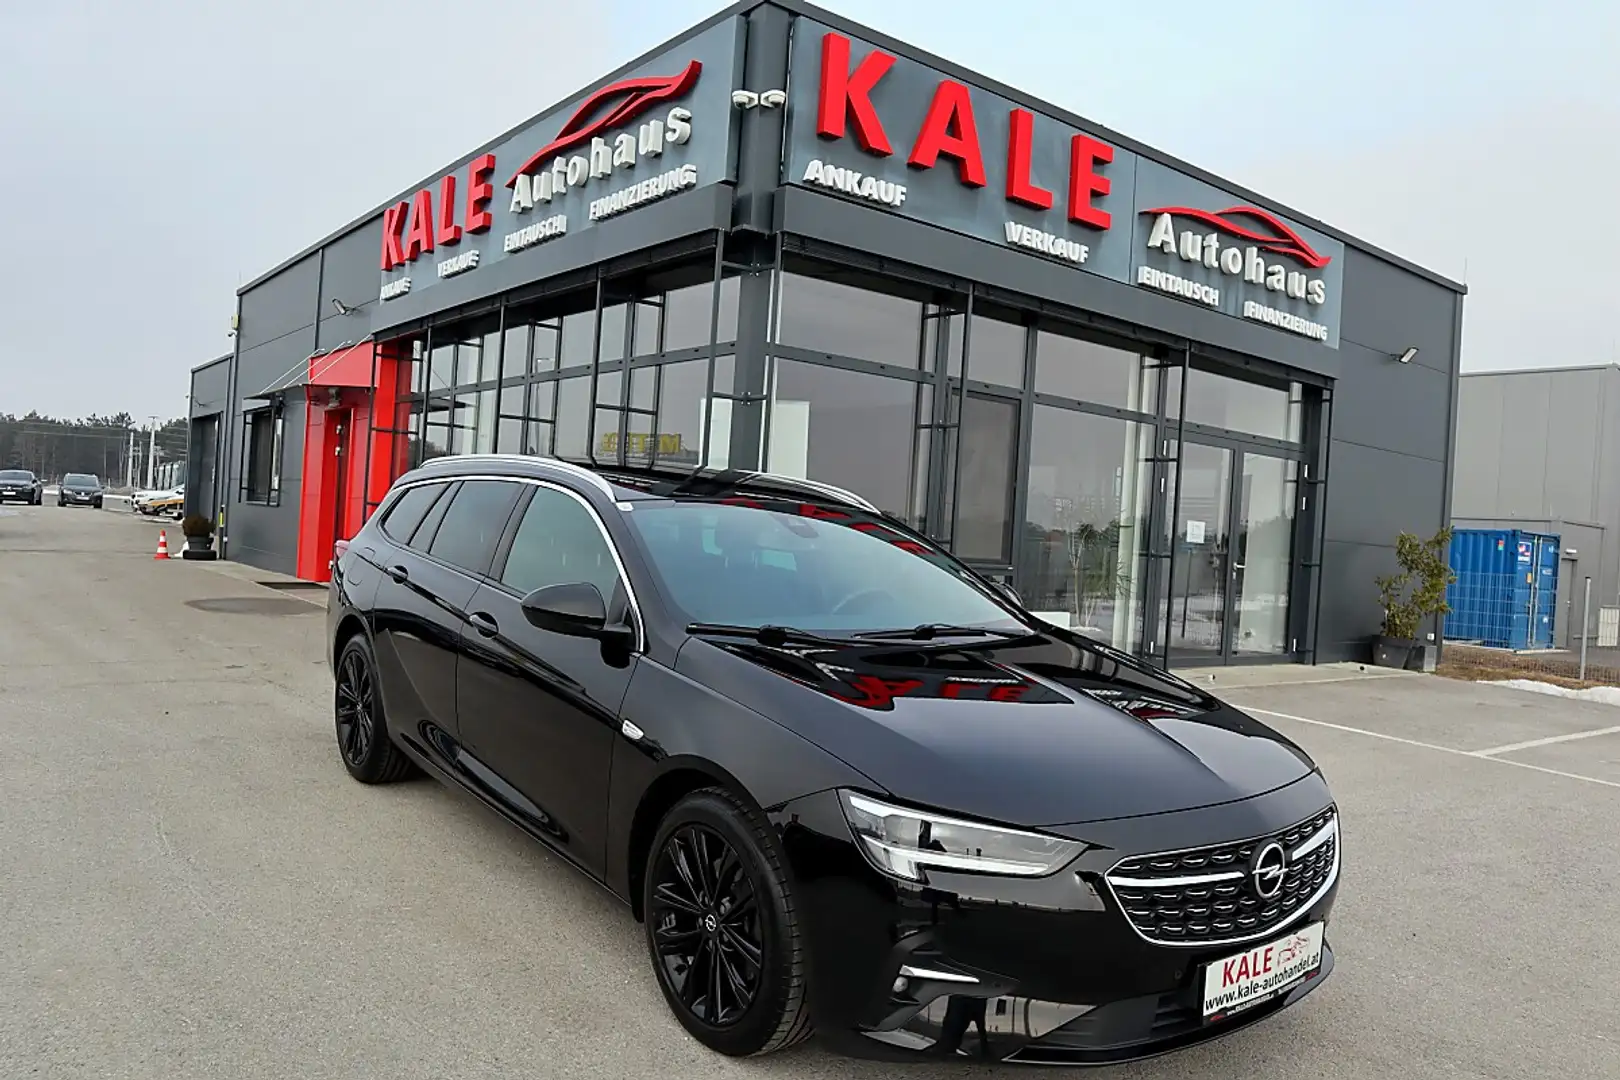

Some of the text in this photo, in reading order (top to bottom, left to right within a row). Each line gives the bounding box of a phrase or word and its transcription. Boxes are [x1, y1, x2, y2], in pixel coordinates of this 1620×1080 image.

[509, 106, 693, 213] Autohaus
[816, 32, 1114, 230] KALE
[381, 154, 496, 271] KALE
[504, 215, 567, 253] EINTAUSCH
[589, 164, 697, 221] FINANZIERUNG
[803, 159, 1328, 341] ANKAUF VERKAUF EINTAUSCH FINANZIERUNG
[1148, 212, 1326, 304] Autohaus
[1205, 952, 1319, 1011] www.kale-autohandel.at
[1222, 946, 1274, 988] KALE
